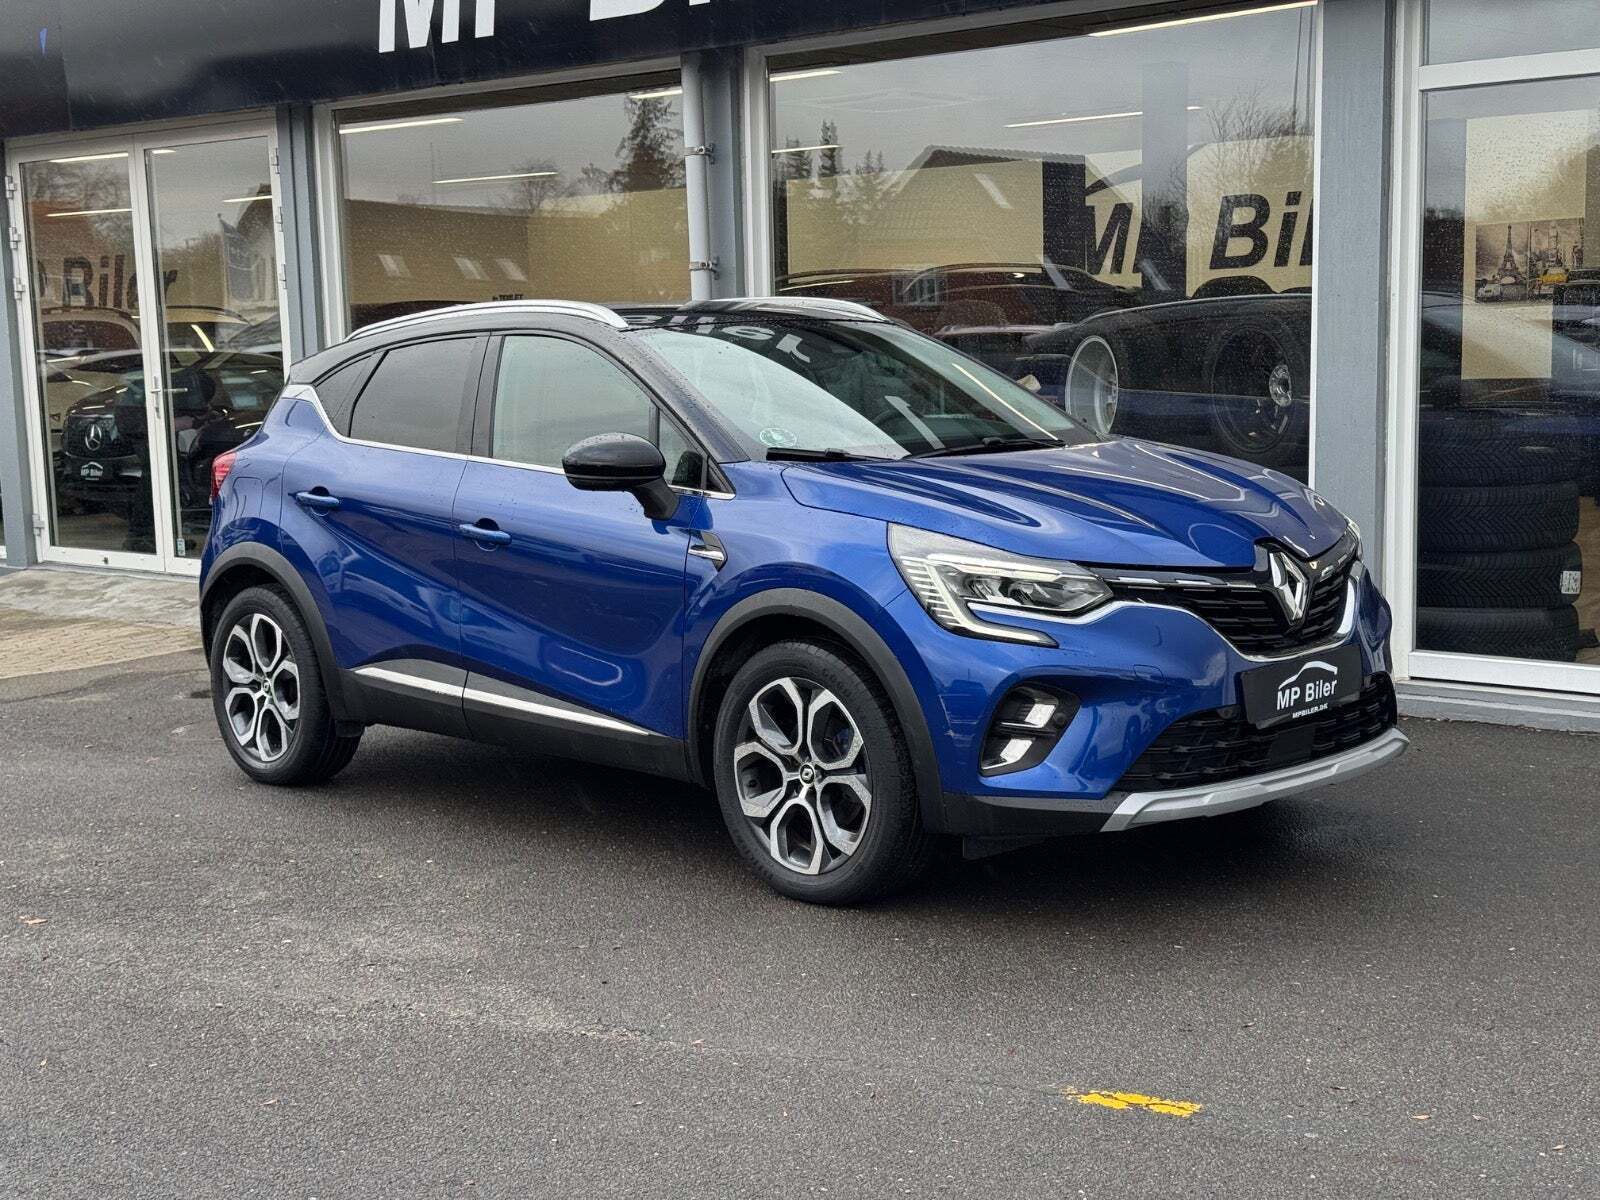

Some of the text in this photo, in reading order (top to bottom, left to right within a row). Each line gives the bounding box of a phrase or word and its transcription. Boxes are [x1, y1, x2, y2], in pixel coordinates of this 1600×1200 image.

[1277, 680, 1337, 710] MP Biler
[1292, 703, 1328, 718] MPBILER.DK
